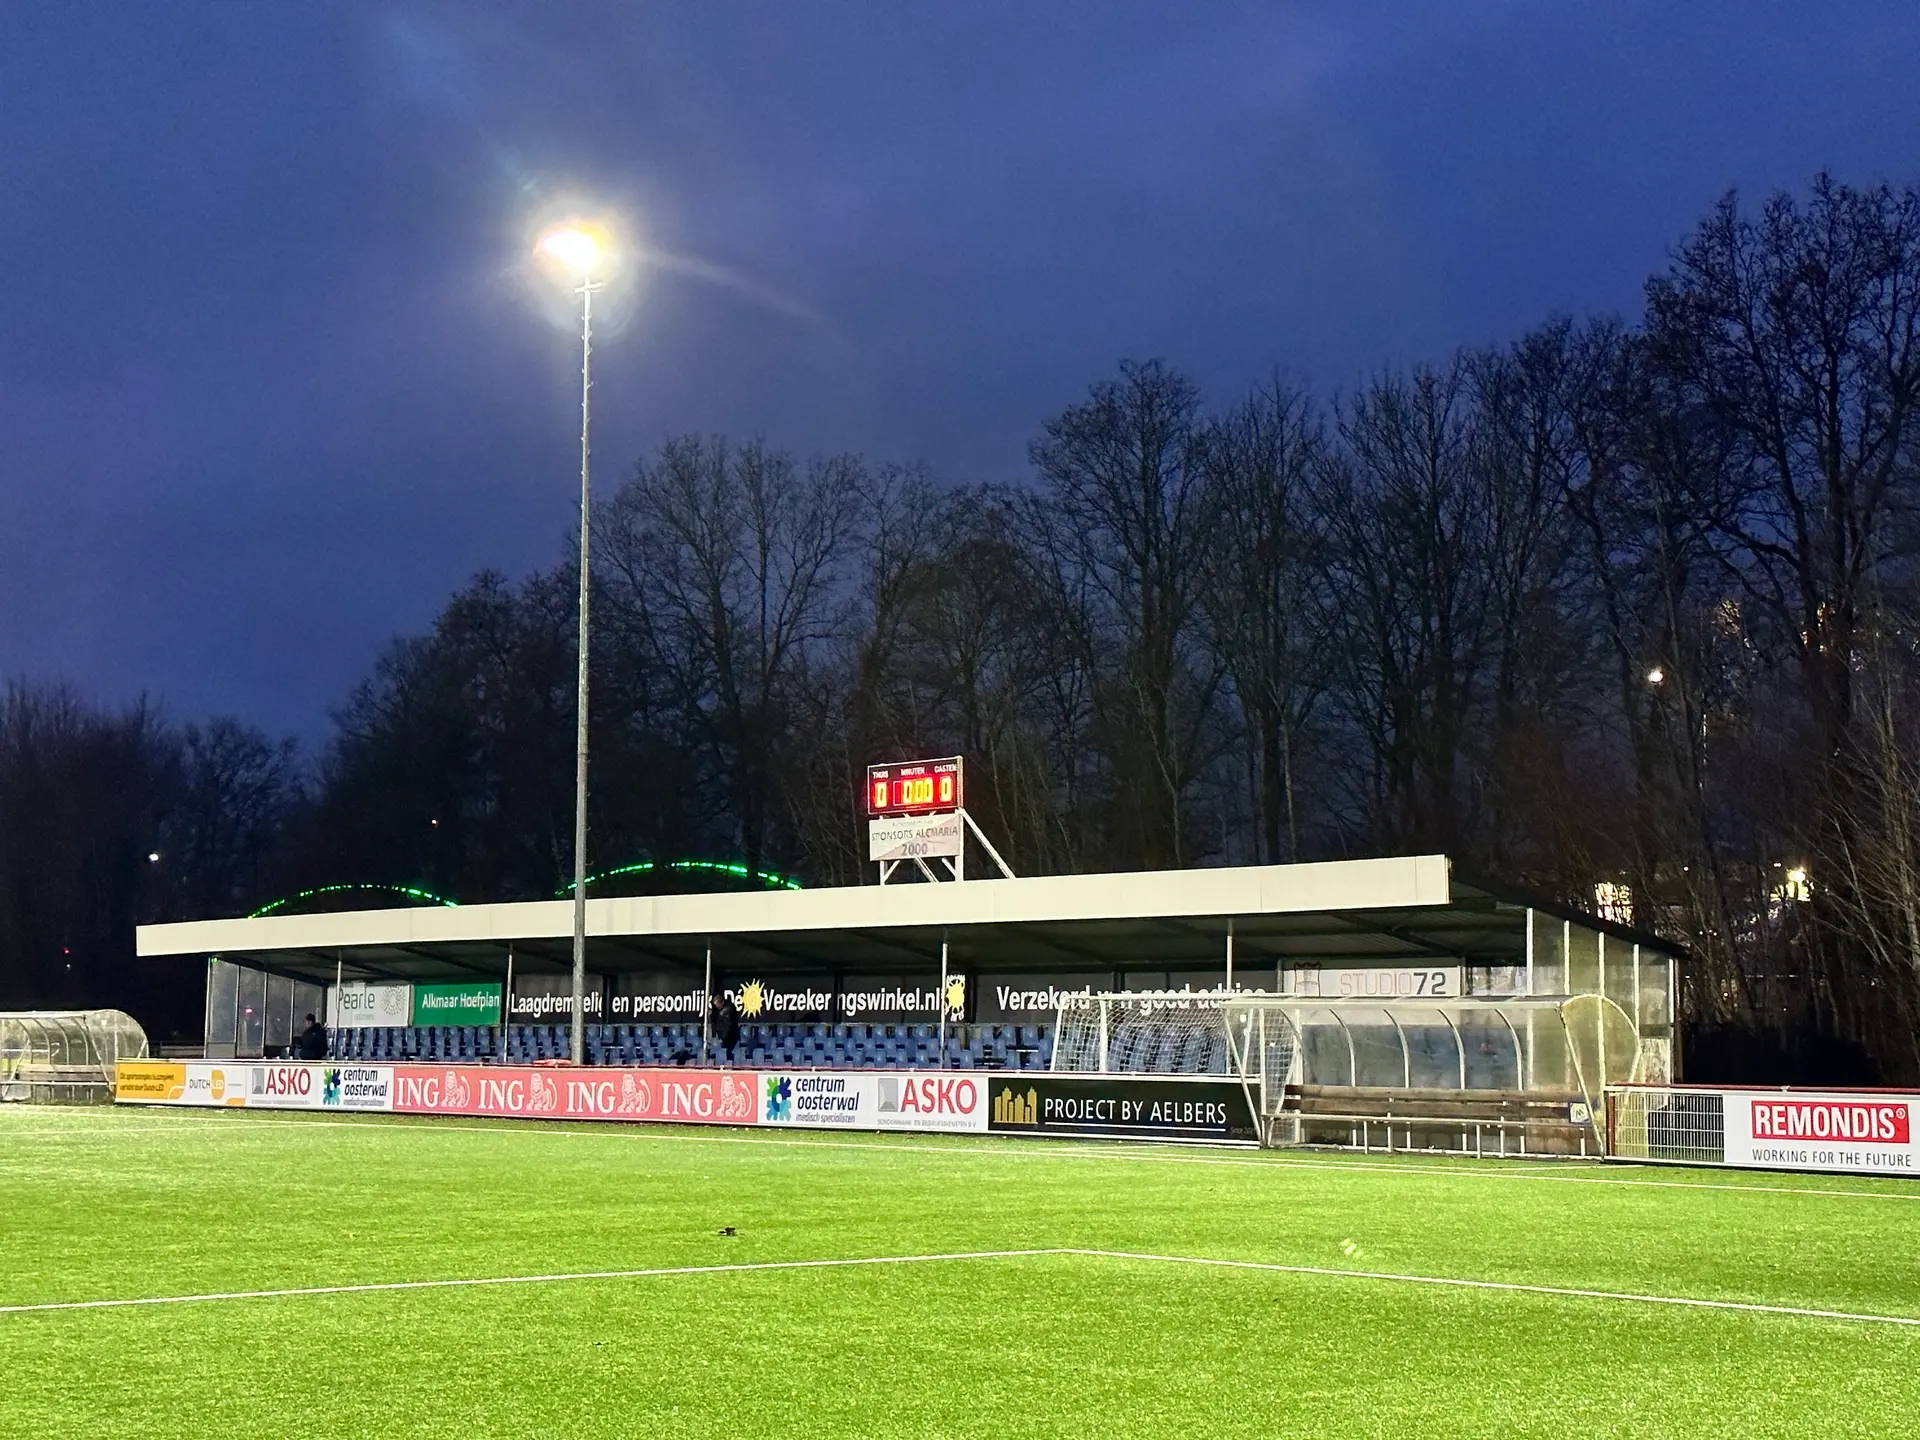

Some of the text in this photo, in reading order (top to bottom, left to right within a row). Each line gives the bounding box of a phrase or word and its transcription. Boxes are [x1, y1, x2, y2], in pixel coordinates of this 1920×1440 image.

[901, 768, 925, 776] MINUTEN
[875, 781, 887, 808] 0
[939, 775, 952, 802] 0
[871, 830, 913, 841] SPONSORS
[901, 843, 928, 857] 2000
[1340, 971, 1446, 995] STUDIO72
[338, 987, 375, 1010] Pearle
[422, 991, 499, 1011] Alkmaar Hoefplan
[510, 992, 602, 1018] Laagdremelig
[612, 996, 629, 1013] en
[763, 987, 941, 1016] Verzekerngswinkel.nl
[996, 985, 1090, 1011] Verzekerd
[189, 1079, 211, 1089] DUTCH
[265, 1068, 311, 1096] ASKO
[344, 1068, 378, 1081] centrum
[795, 1076, 845, 1093] centrum
[344, 1081, 388, 1097] oosterwal
[397, 1076, 440, 1107] ING
[477, 1078, 525, 1111] ING
[566, 1080, 616, 1114] ING
[660, 1083, 713, 1117] ING
[797, 1091, 860, 1111] oosterwal
[901, 1078, 977, 1115] ASKO
[1044, 1098, 1226, 1124] PROJECT BY AELBERS
[1755, 1104, 1896, 1139] REMONDIS
[1752, 1148, 1913, 1167] WORKING FOR THE FUTURE
